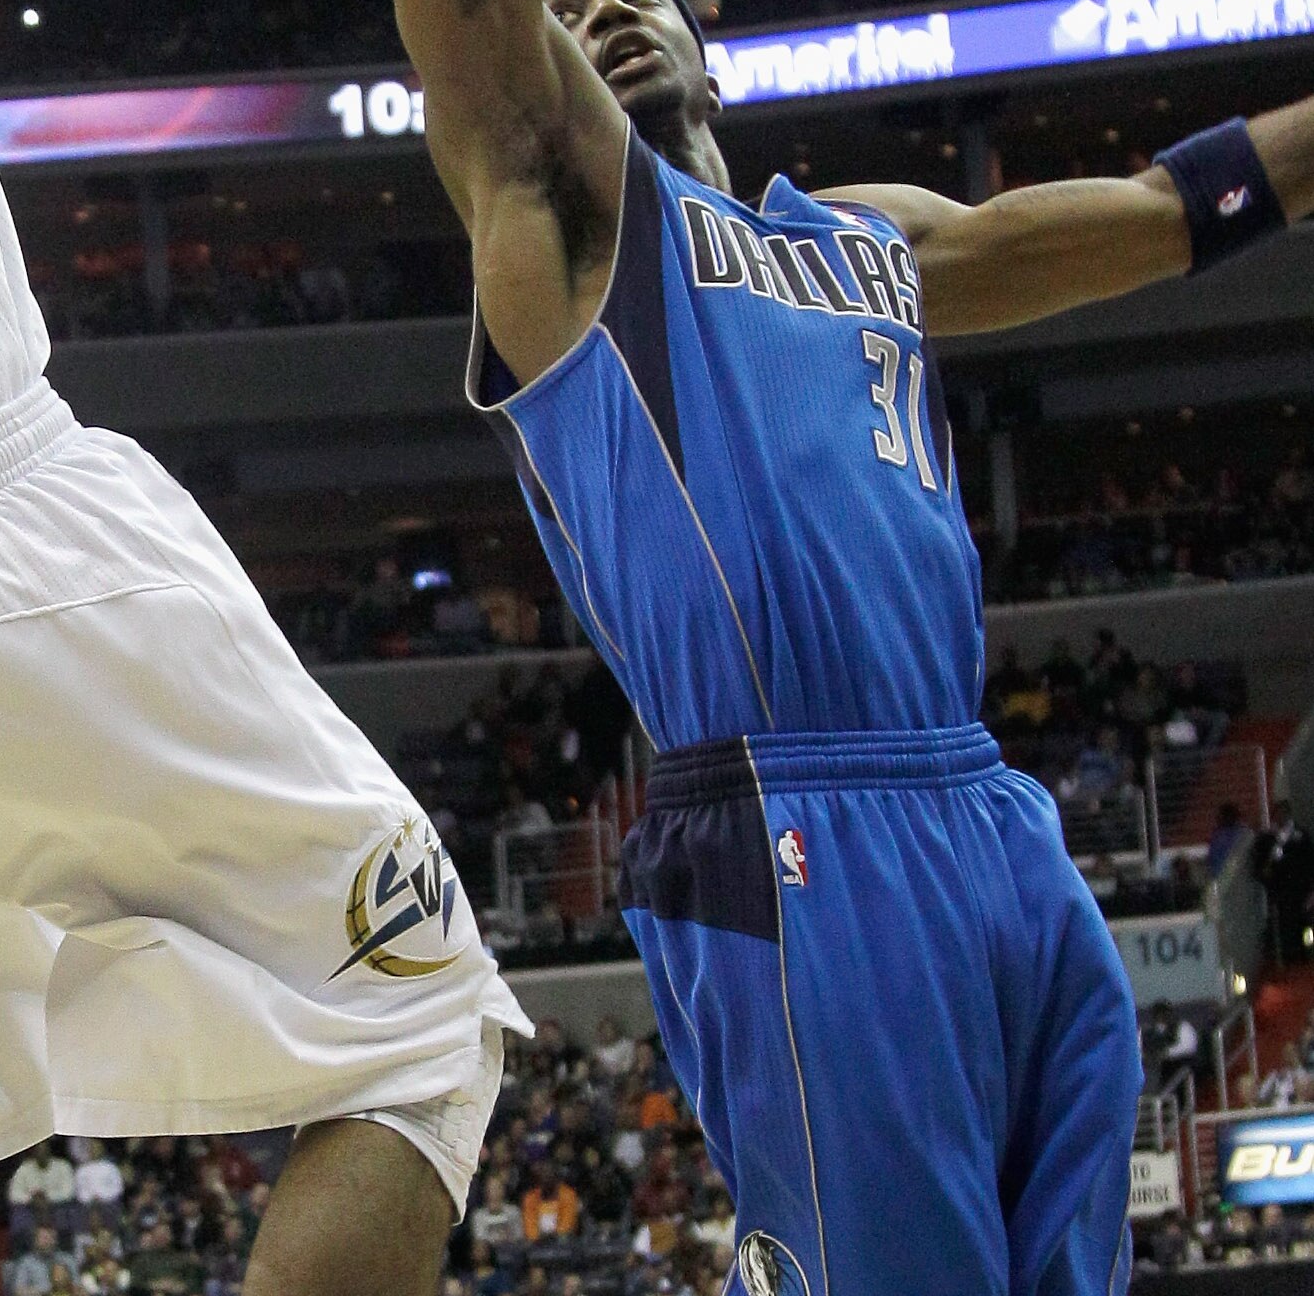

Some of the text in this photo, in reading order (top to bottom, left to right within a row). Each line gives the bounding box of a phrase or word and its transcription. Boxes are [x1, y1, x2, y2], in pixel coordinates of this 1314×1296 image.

[679, 195, 924, 340] DALLAS
[862, 328, 938, 492] 31
[1136, 930, 1206, 968] 104
[1226, 1142, 1314, 1183] BU
